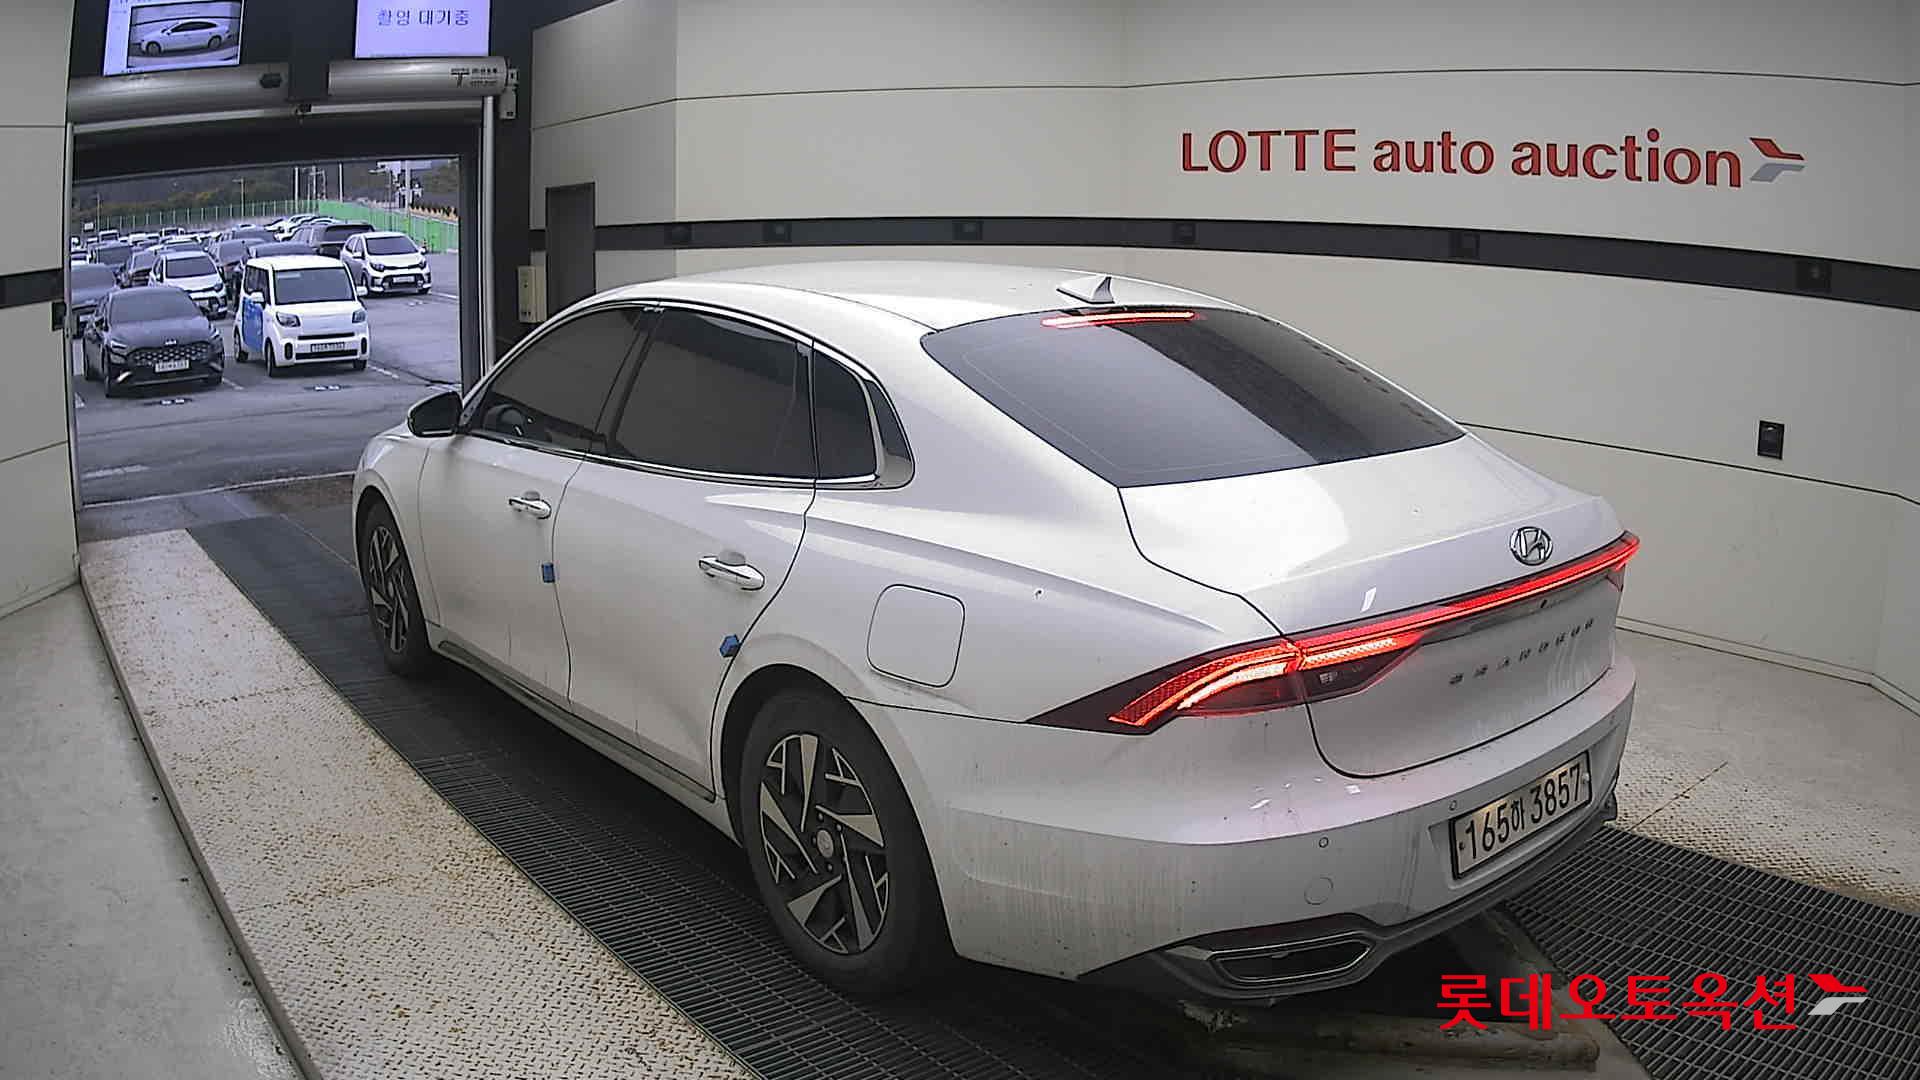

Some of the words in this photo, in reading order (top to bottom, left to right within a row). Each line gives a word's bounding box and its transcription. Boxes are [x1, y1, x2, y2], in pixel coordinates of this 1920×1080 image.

[418, 8, 470, 26] 대기중
[1182, 128, 1357, 174] LOTTE
[1373, 130, 1494, 175] auto
[1511, 127, 1743, 189] auction
[1465, 797, 1525, 859] 165하
[1530, 762, 1581, 824] 3857
